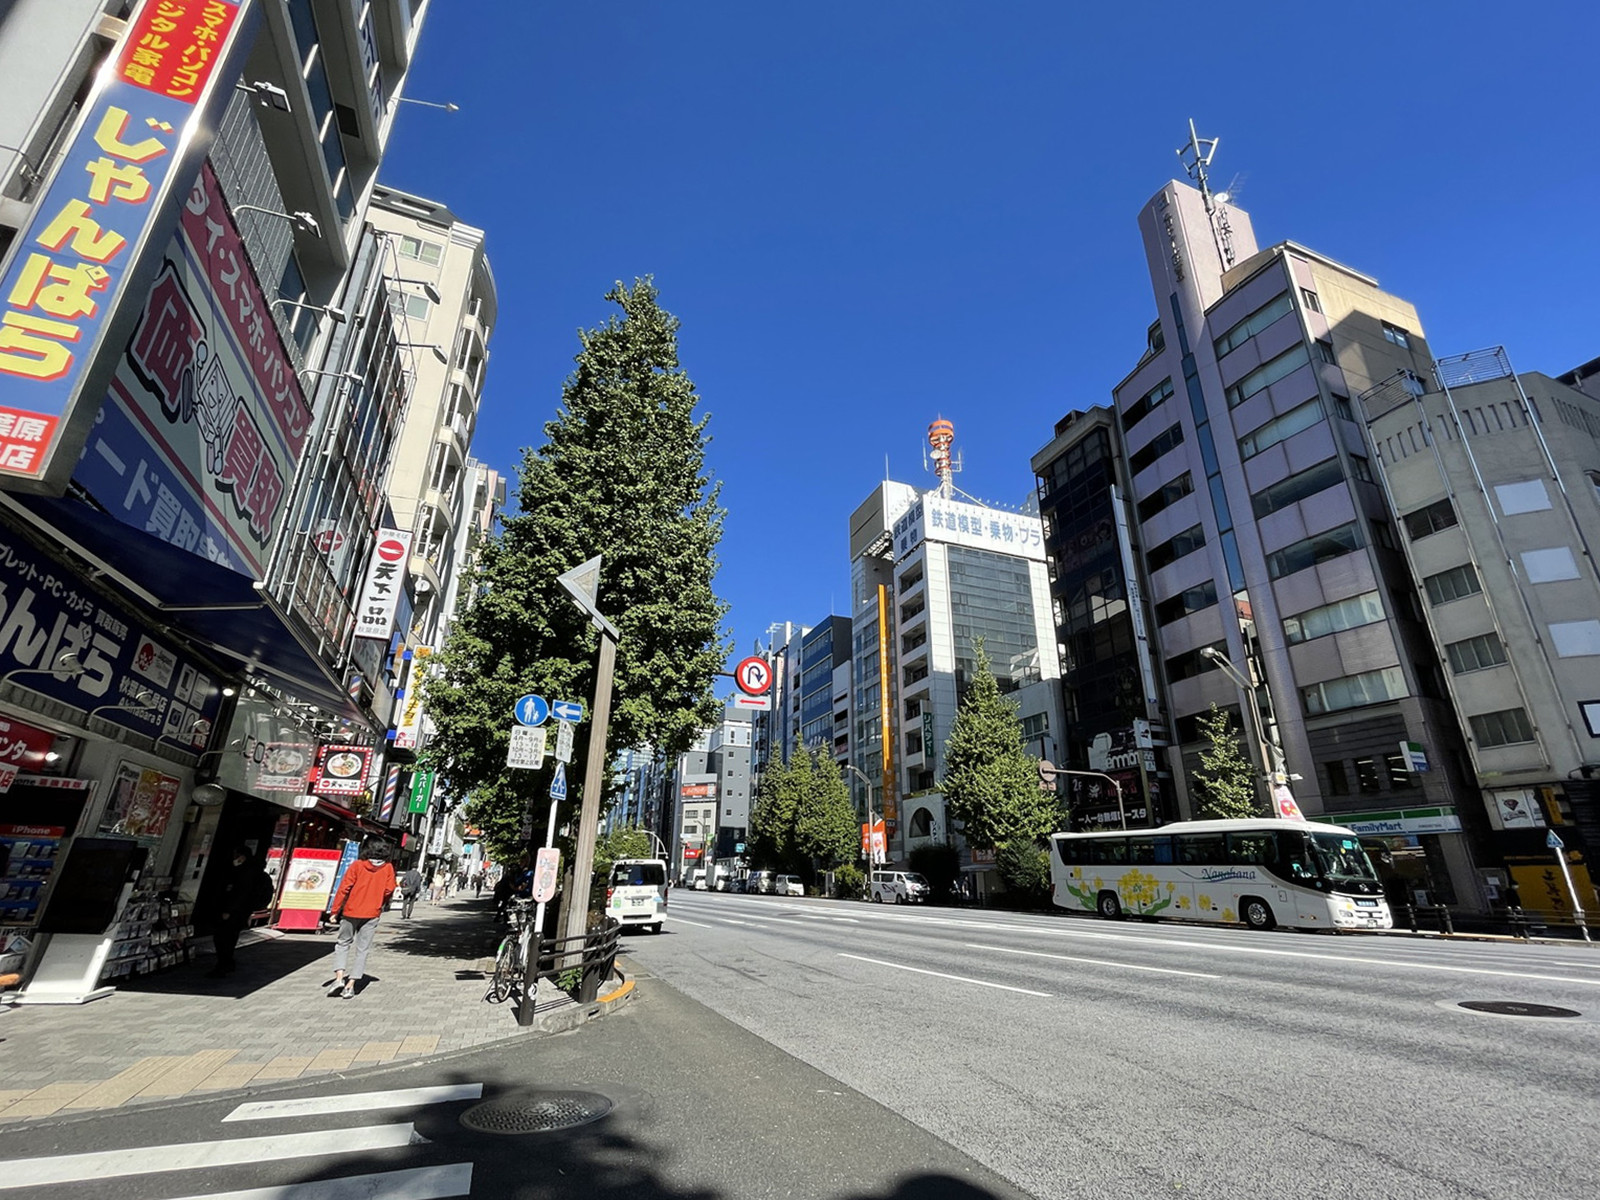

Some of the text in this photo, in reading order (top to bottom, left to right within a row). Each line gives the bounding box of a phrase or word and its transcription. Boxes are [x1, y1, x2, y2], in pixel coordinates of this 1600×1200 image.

[166, 0, 227, 96] スマホ・パソコン
[0, 105, 174, 381] じゃんぱら
[220, 402, 283, 542] 買取
[362, 562, 399, 626] 天下一品
[12, 825, 51, 835] iPhone
[1351, 820, 1403, 833] FamilyMart
[1201, 867, 1256, 881] Nanohana
